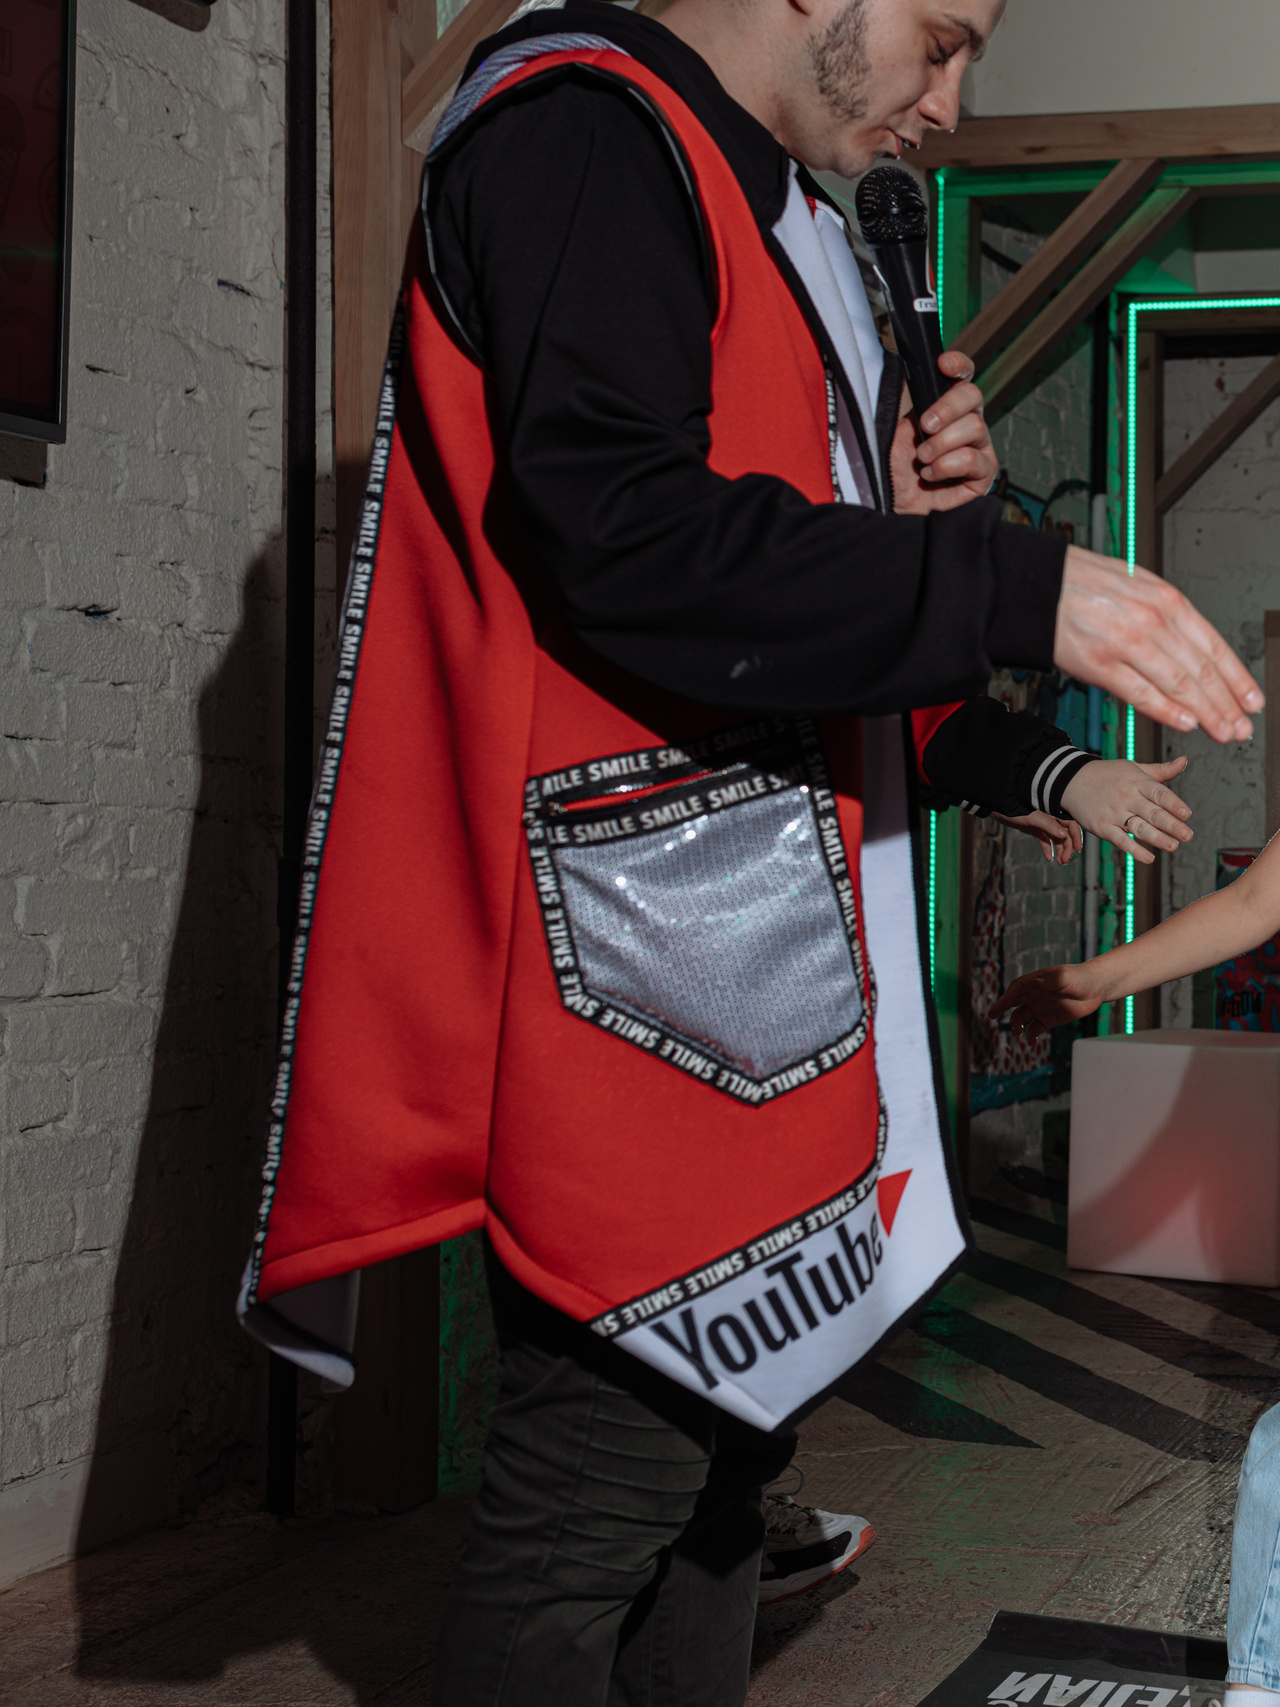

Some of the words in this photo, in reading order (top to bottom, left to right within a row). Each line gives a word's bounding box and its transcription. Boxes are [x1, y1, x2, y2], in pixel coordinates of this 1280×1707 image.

[366, 435, 390, 494] SMILE
[355, 499, 381, 558] SMILE
[345, 560, 372, 619] SMILE
[336, 622, 362, 680] SMILE
[326, 684, 350, 742] SMILE
[316, 747, 341, 805] SMILE
[587, 753, 651, 782] SMILE
[304, 808, 328, 866] SMILE
[572, 816, 637, 843] SMILE
[639, 795, 704, 830] SMILE
[707, 775, 767, 809] SMILE
[819, 815, 847, 876] SMILE
[298, 870, 317, 929] SMILE
[530, 845, 561, 905] SMILE
[287, 934, 307, 992] SMILE
[545, 907, 575, 968] SMILE
[599, 1008, 661, 1048] SMILE
[818, 1025, 866, 1069] SMILE
[659, 1039, 718, 1080] SMILE
[761, 1060, 819, 1099] SMILE
[261, 1123, 283, 1181] SMILE
[805, 1191, 857, 1232] SMILE
[747, 1221, 804, 1264] SMILE
[649, 1210, 884, 1391] YouTube
[684, 1252, 745, 1296] SMILE
[623, 1282, 685, 1326] SMILE
[987, 1671, 1192, 1707] ЕЛАЙ
